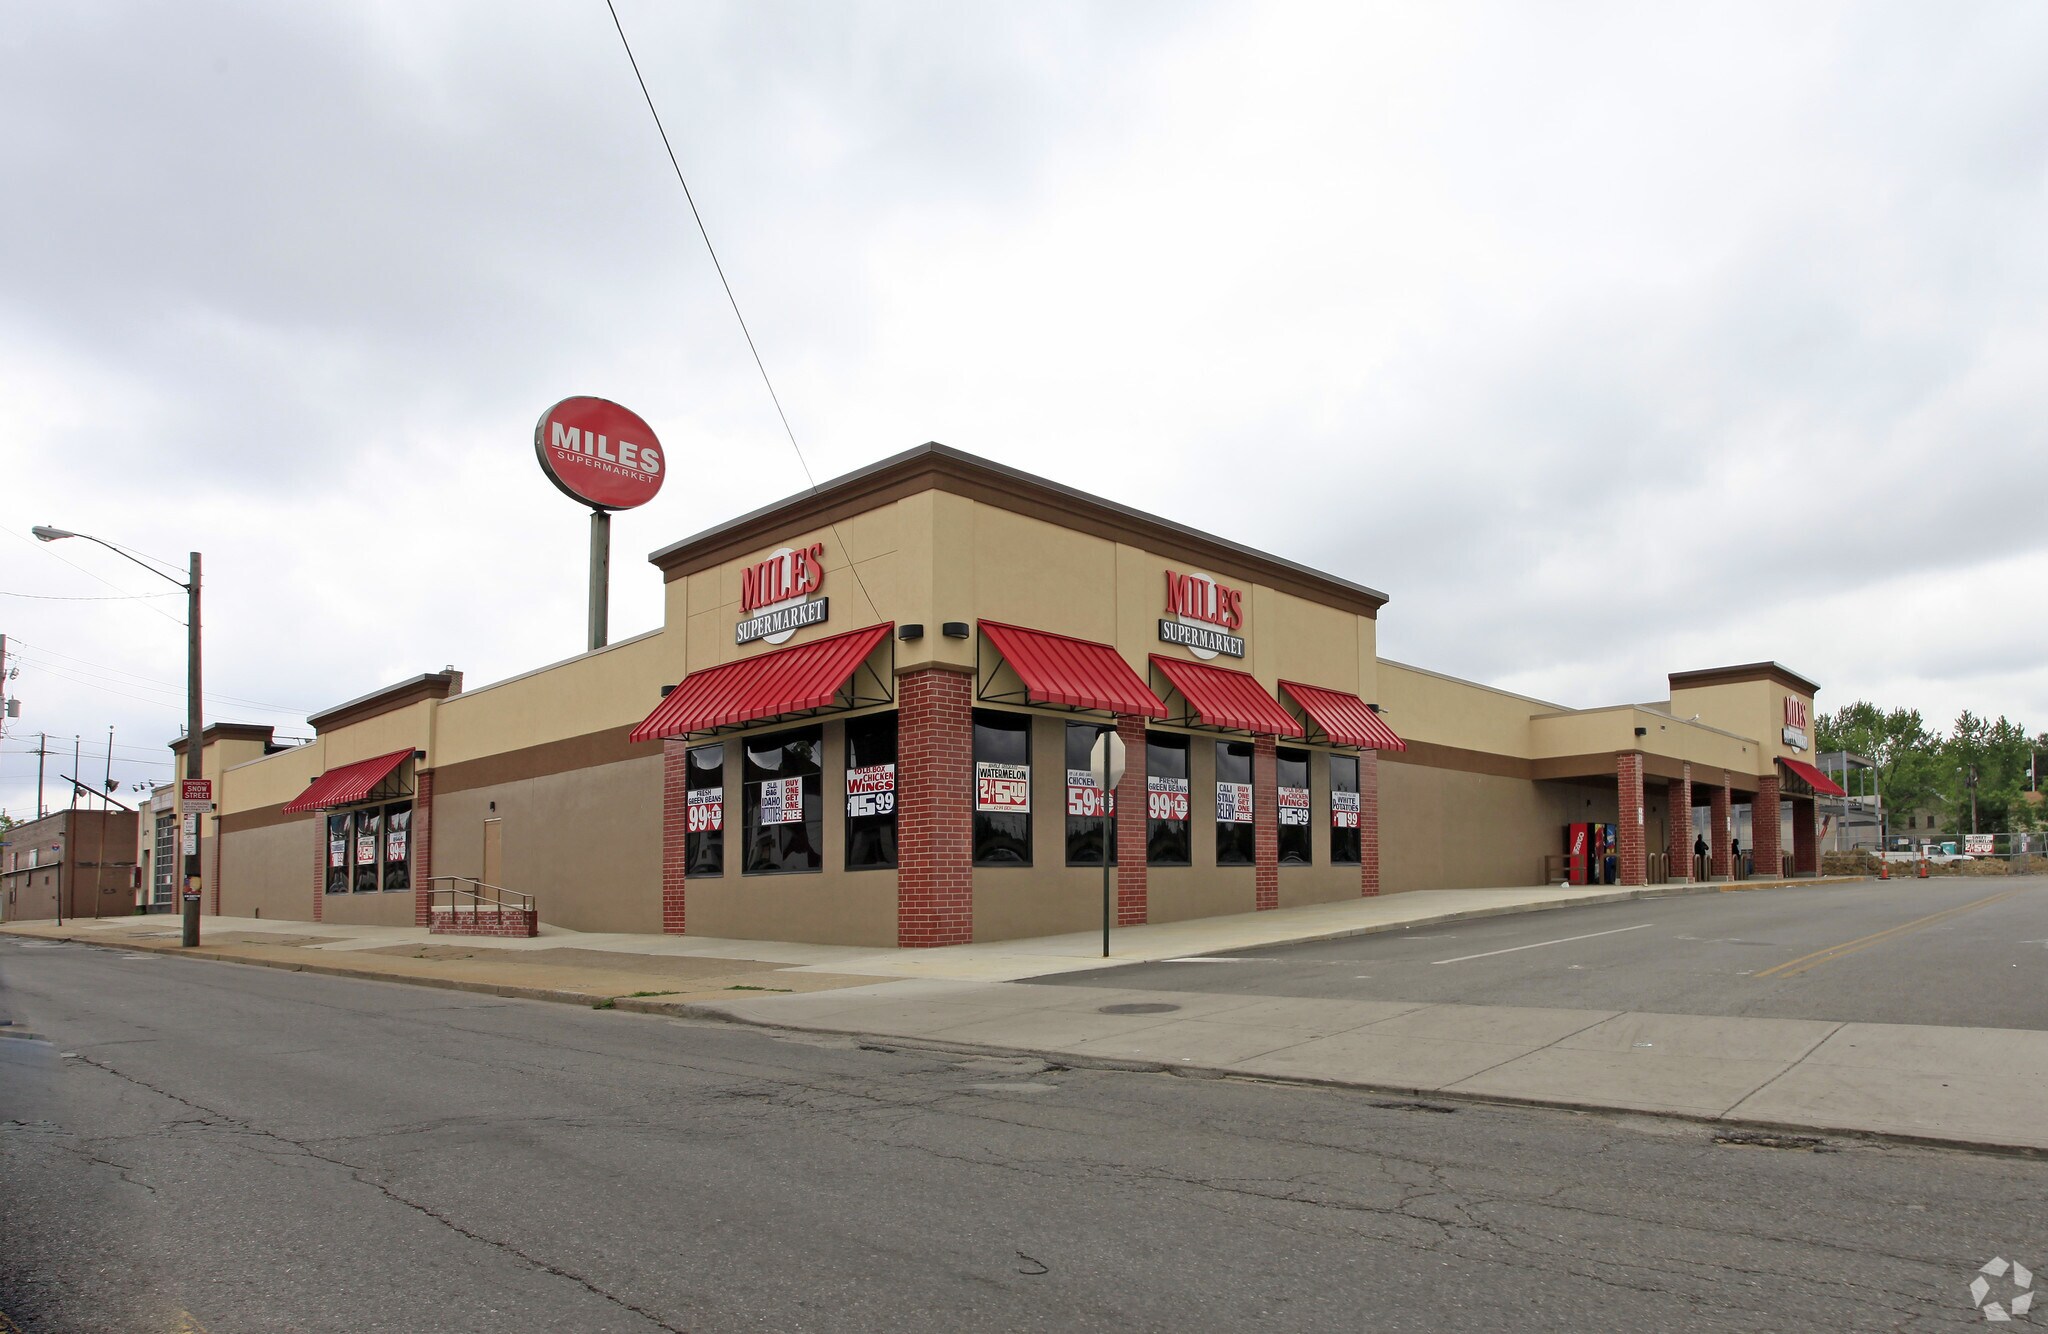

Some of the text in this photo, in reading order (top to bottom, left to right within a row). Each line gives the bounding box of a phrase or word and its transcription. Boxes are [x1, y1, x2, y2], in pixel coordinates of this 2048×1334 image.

[552, 421, 660, 473] MILES
[557, 451, 653, 483] SUPERMARKET
[739, 543, 823, 613] MILES
[1165, 570, 1243, 630] MILES
[737, 600, 824, 642] SUPERMARKET
[1163, 621, 1243, 655] SUPERMARKET
[1784, 696, 1806, 730] MILES
[863, 772, 893, 782] CHICKEN
[979, 768, 1026, 780] WATERMELON
[1068, 776, 1095, 787] CHICKEN
[1160, 777, 1178, 785] FRESH
[697, 789, 711, 797] FRESH
[1149, 782, 1188, 793] GREEN BEANS
[1219, 784, 1232, 793] CALI
[689, 795, 721, 805] GREEN BEANS
[762, 797, 780, 807] IDAHO
[785, 801, 799, 809] ONE
[1338, 796, 1356, 804] WHITE
[1174, 801, 1188, 812] LB
[711, 810, 722, 820] LB
[782, 810, 802, 821] FREE
[1235, 812, 1252, 820] FREE
